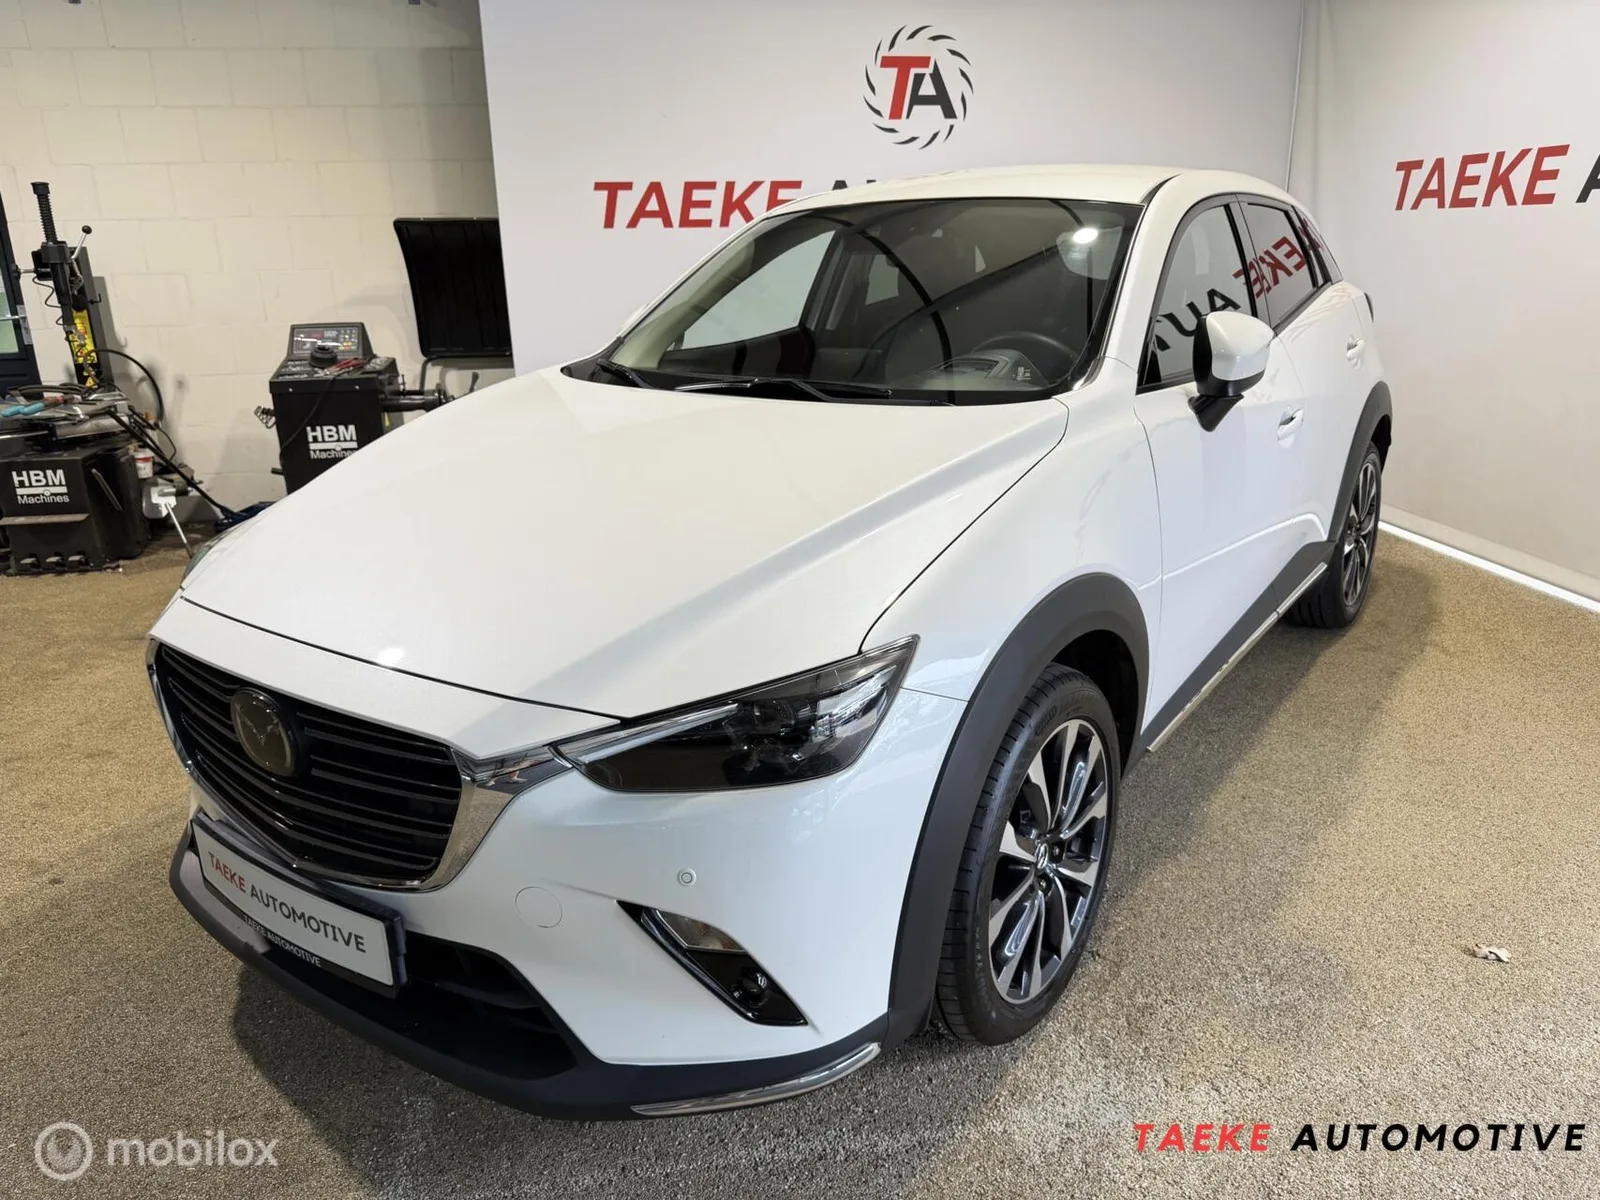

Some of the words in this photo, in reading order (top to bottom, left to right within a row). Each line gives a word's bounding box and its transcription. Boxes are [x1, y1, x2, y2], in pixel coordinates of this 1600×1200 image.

[880, 55, 958, 121] TA
[1395, 144, 1570, 211] TAEKE
[306, 424, 357, 442] HBM
[310, 449, 357, 460] Machine
[11, 468, 67, 487] HBM
[17, 494, 70, 505] Machines
[208, 851, 246, 894] TAEKE
[250, 884, 367, 954] AUTOMOTIVE
[267, 930, 322, 968] AUTOMOTIVE
